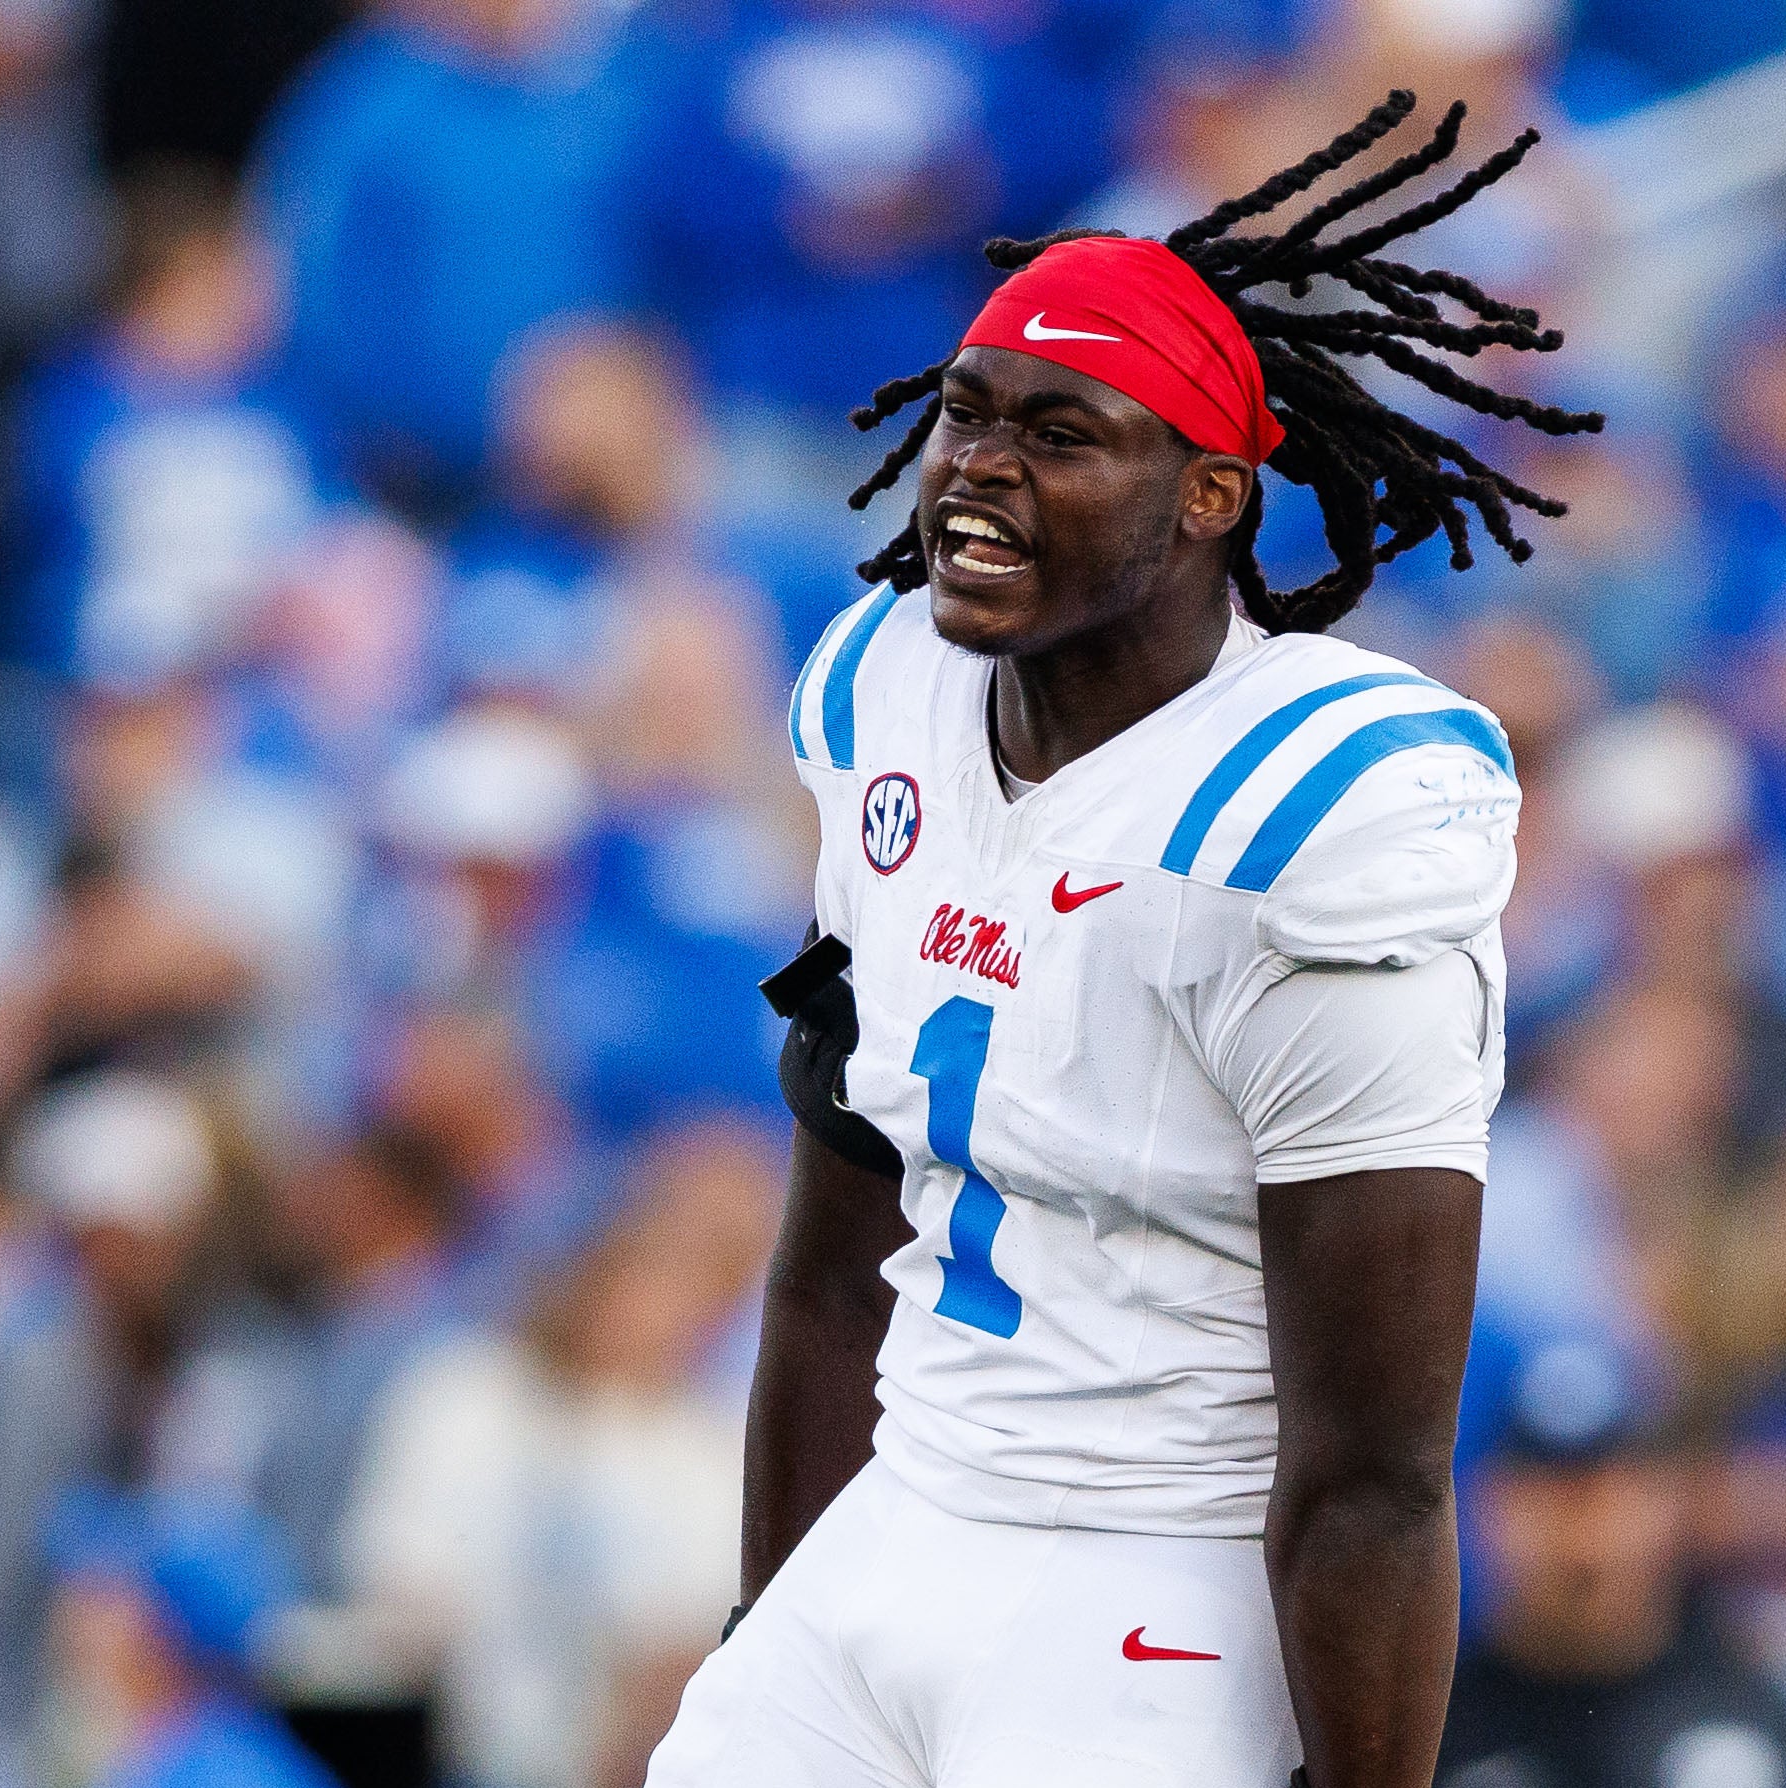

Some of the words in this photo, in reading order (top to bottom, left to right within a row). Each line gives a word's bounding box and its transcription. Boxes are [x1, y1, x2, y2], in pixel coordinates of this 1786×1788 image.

[864, 779, 917, 867] SEC
[919, 902, 966, 965] Ole
[959, 914, 1022, 990] Miss
[908, 994, 1023, 1340] 1
